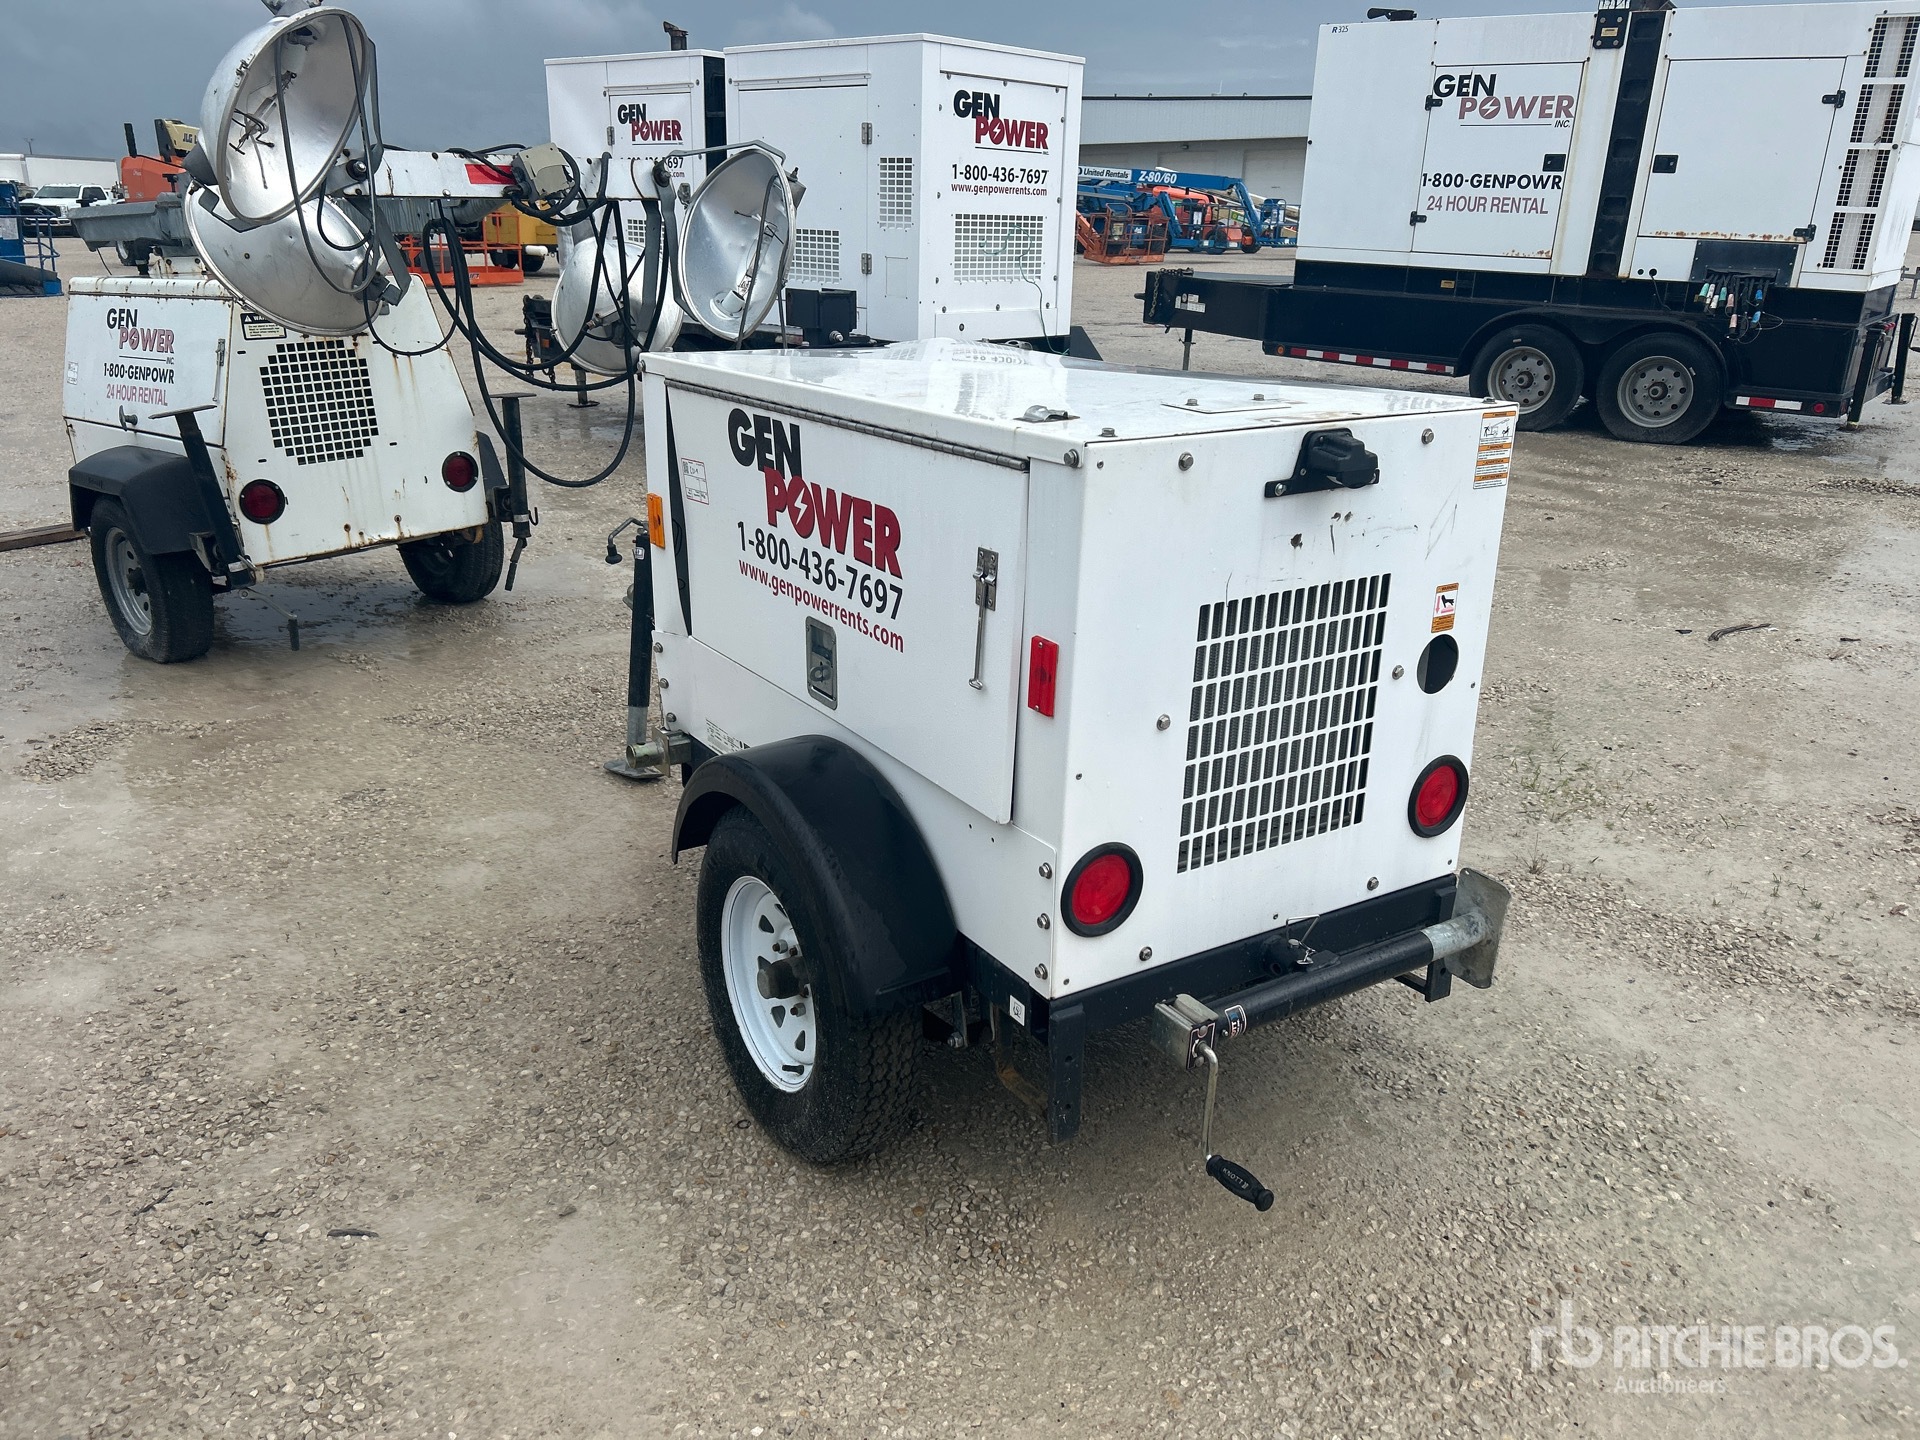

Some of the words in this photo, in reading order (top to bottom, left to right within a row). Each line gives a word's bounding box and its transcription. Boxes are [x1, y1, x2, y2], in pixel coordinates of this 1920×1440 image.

[1433, 74, 1496, 97] GEN
[617, 103, 647, 124] GEN
[953, 89, 1000, 120] GEN
[1458, 95, 1575, 120] POWER
[631, 119, 683, 142] POWER
[975, 115, 1049, 150] POWER
[1554, 120, 1571, 128] INC.
[952, 163, 1048, 185] 1-800-436-7697
[1083, 167, 1104, 177] United
[1105, 169, 1129, 179] Rentals
[1138, 170, 1178, 184] Z-80/60
[1421, 172, 1563, 190] 1-800-GENPOWR
[951, 183, 1048, 196] www.genpowerrents.com
[1426, 195, 1443, 211] 24
[1445, 196, 1488, 212] HOUR
[1490, 196, 1549, 214] RENTAL
[106, 308, 138, 329] GEN
[118, 326, 175, 354] POWER
[103, 362, 175, 385] 1-800-GENPOWR
[106, 383, 115, 400] 24
[116, 384, 137, 403] HOUR
[138, 386, 168, 406] RENTAL
[728, 408, 802, 479] GEN
[764, 465, 904, 580] POWER
[737, 521, 904, 621] 1-800-436-7697
[738, 559, 904, 654] www.genpowerrents.com
